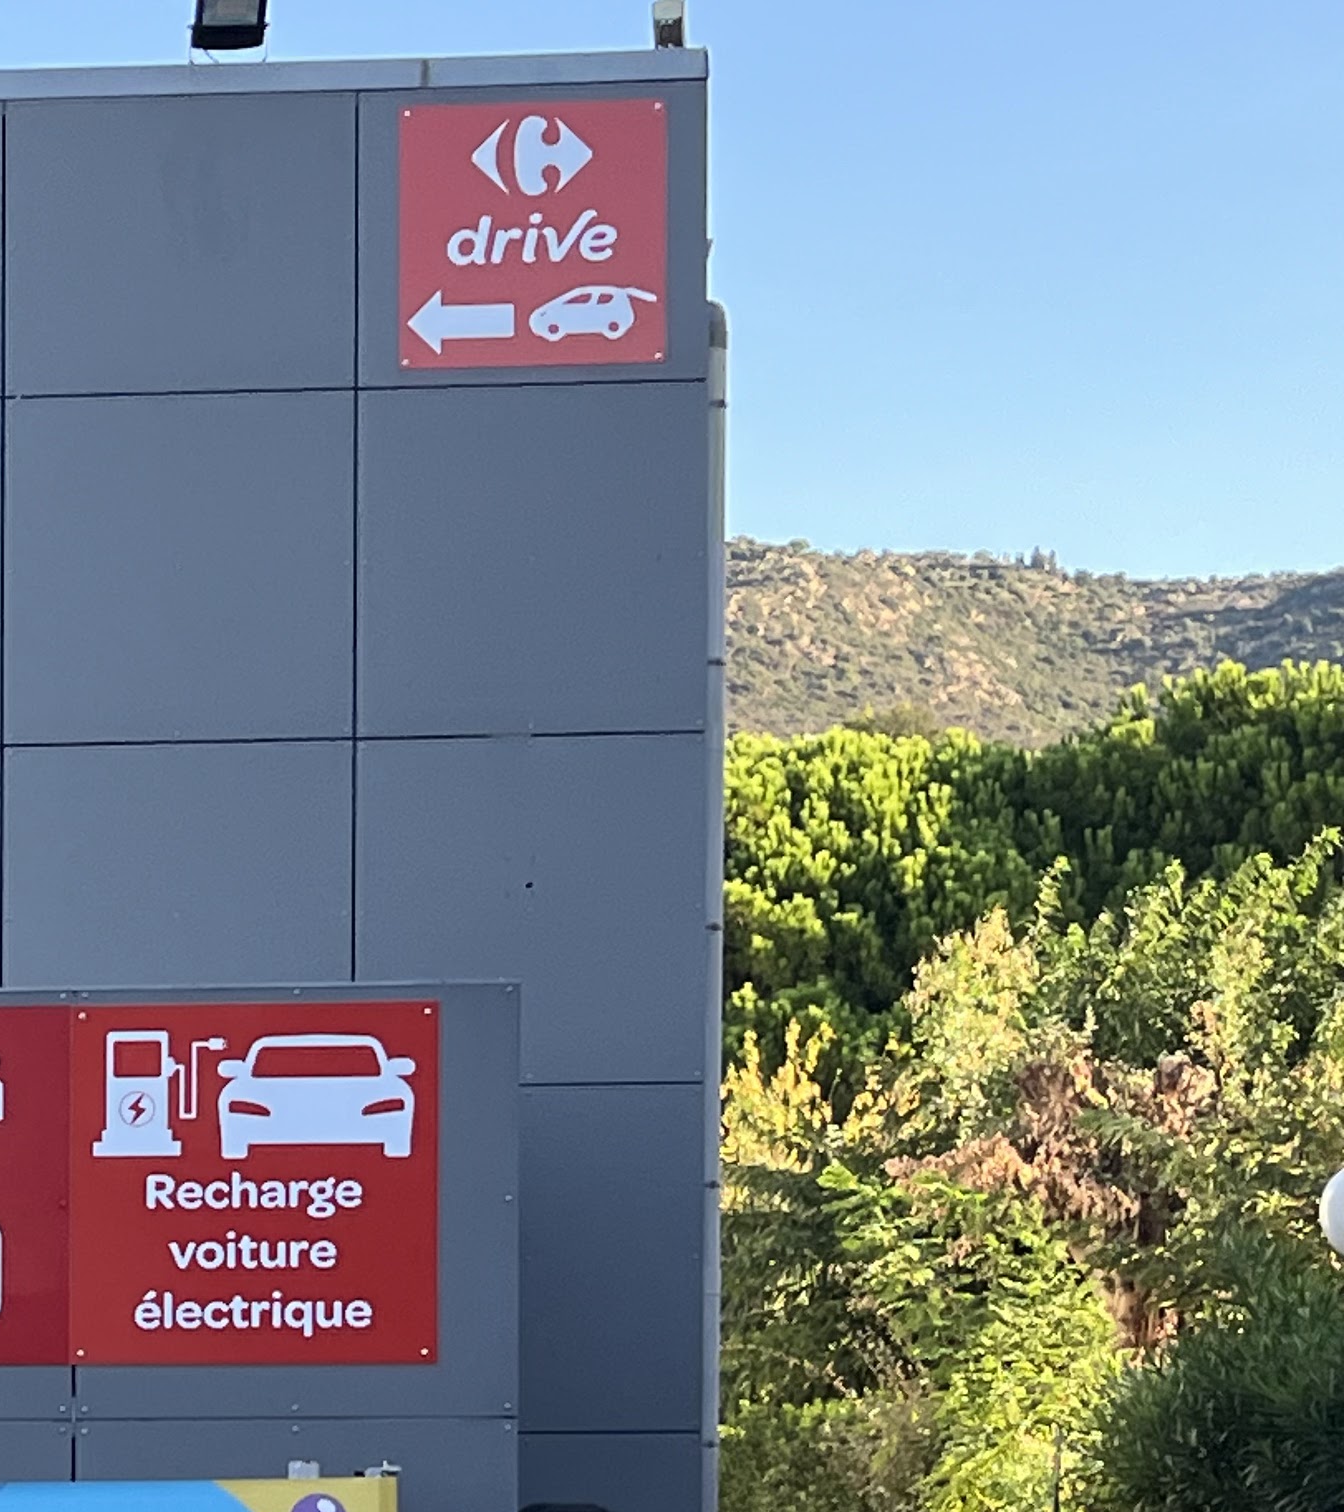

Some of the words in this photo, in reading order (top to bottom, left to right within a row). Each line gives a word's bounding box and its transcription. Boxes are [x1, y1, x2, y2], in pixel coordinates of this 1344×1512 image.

[447, 209, 617, 266] drive
[145, 1171, 363, 1218] Recharge
[168, 1230, 338, 1269] voiture
[134, 1291, 372, 1337] électrique
